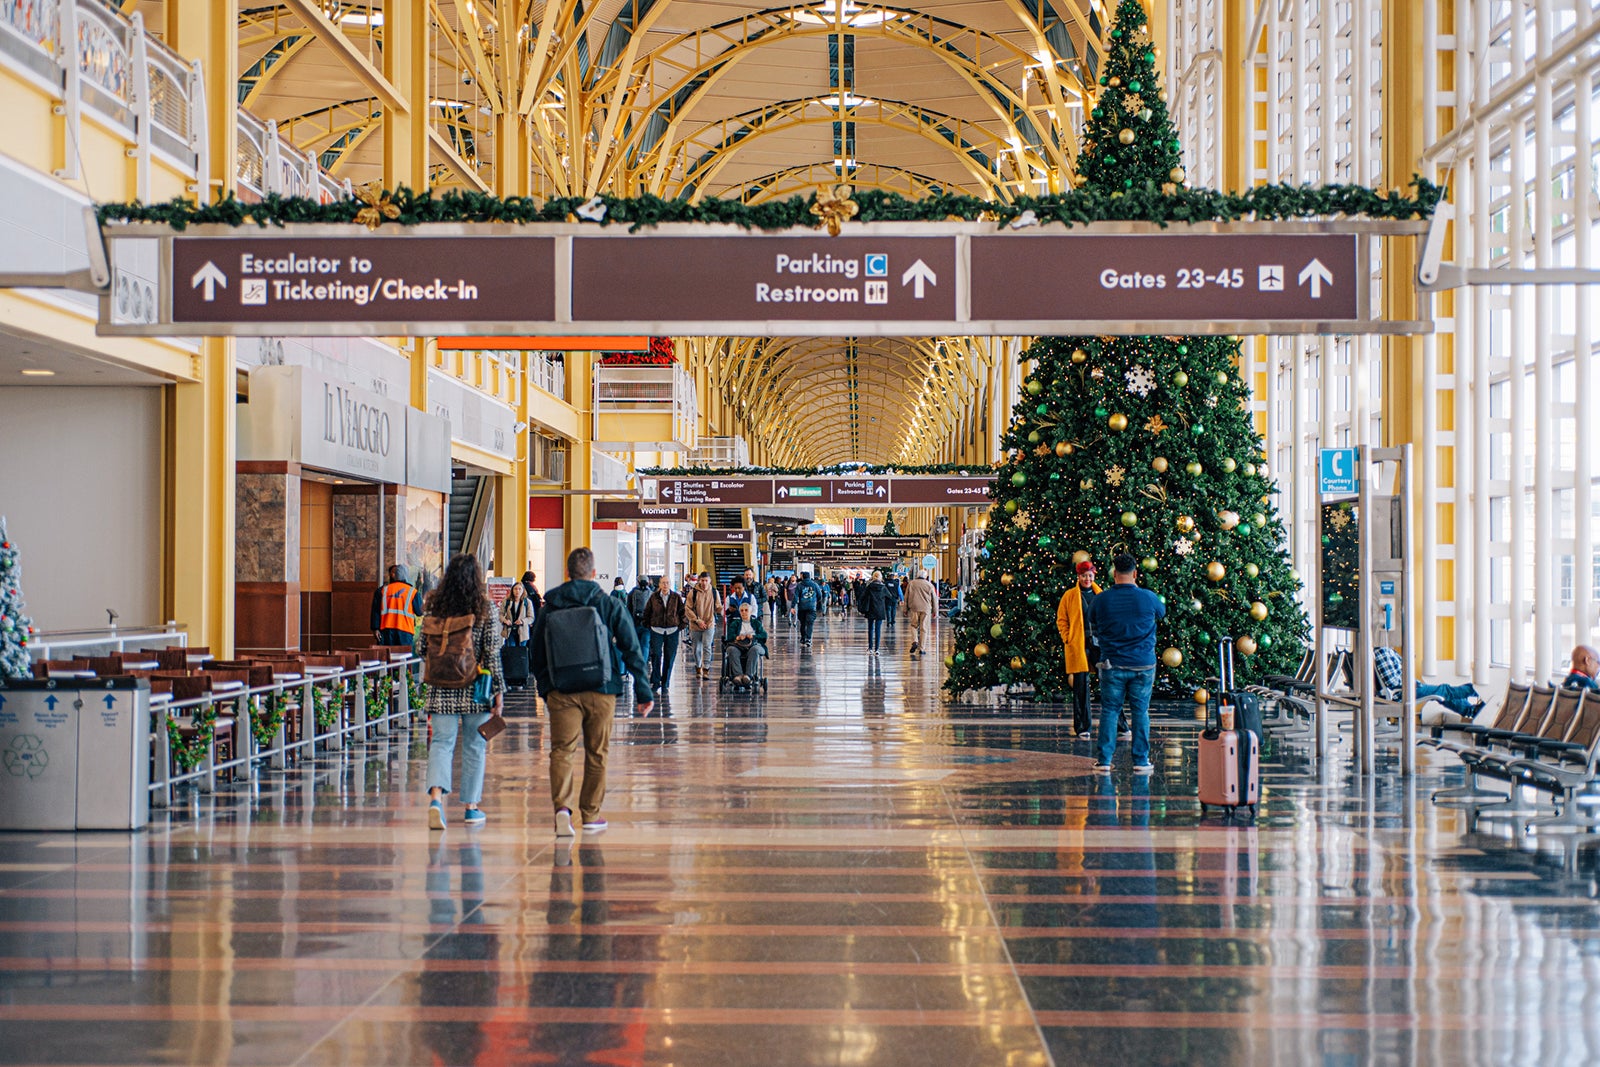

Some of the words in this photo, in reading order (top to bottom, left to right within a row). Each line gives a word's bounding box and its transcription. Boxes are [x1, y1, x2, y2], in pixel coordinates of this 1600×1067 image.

[241, 252, 340, 274] Escalator
[350, 256, 372, 274] to
[776, 253, 859, 278] Parking
[1100, 268, 1166, 288] Gates
[1176, 268, 1244, 288] 23-45
[273, 277, 478, 305] Ticketing/Check-In
[756, 283, 859, 302] Restroom
[1322, 477, 1351, 485] Courtesy
